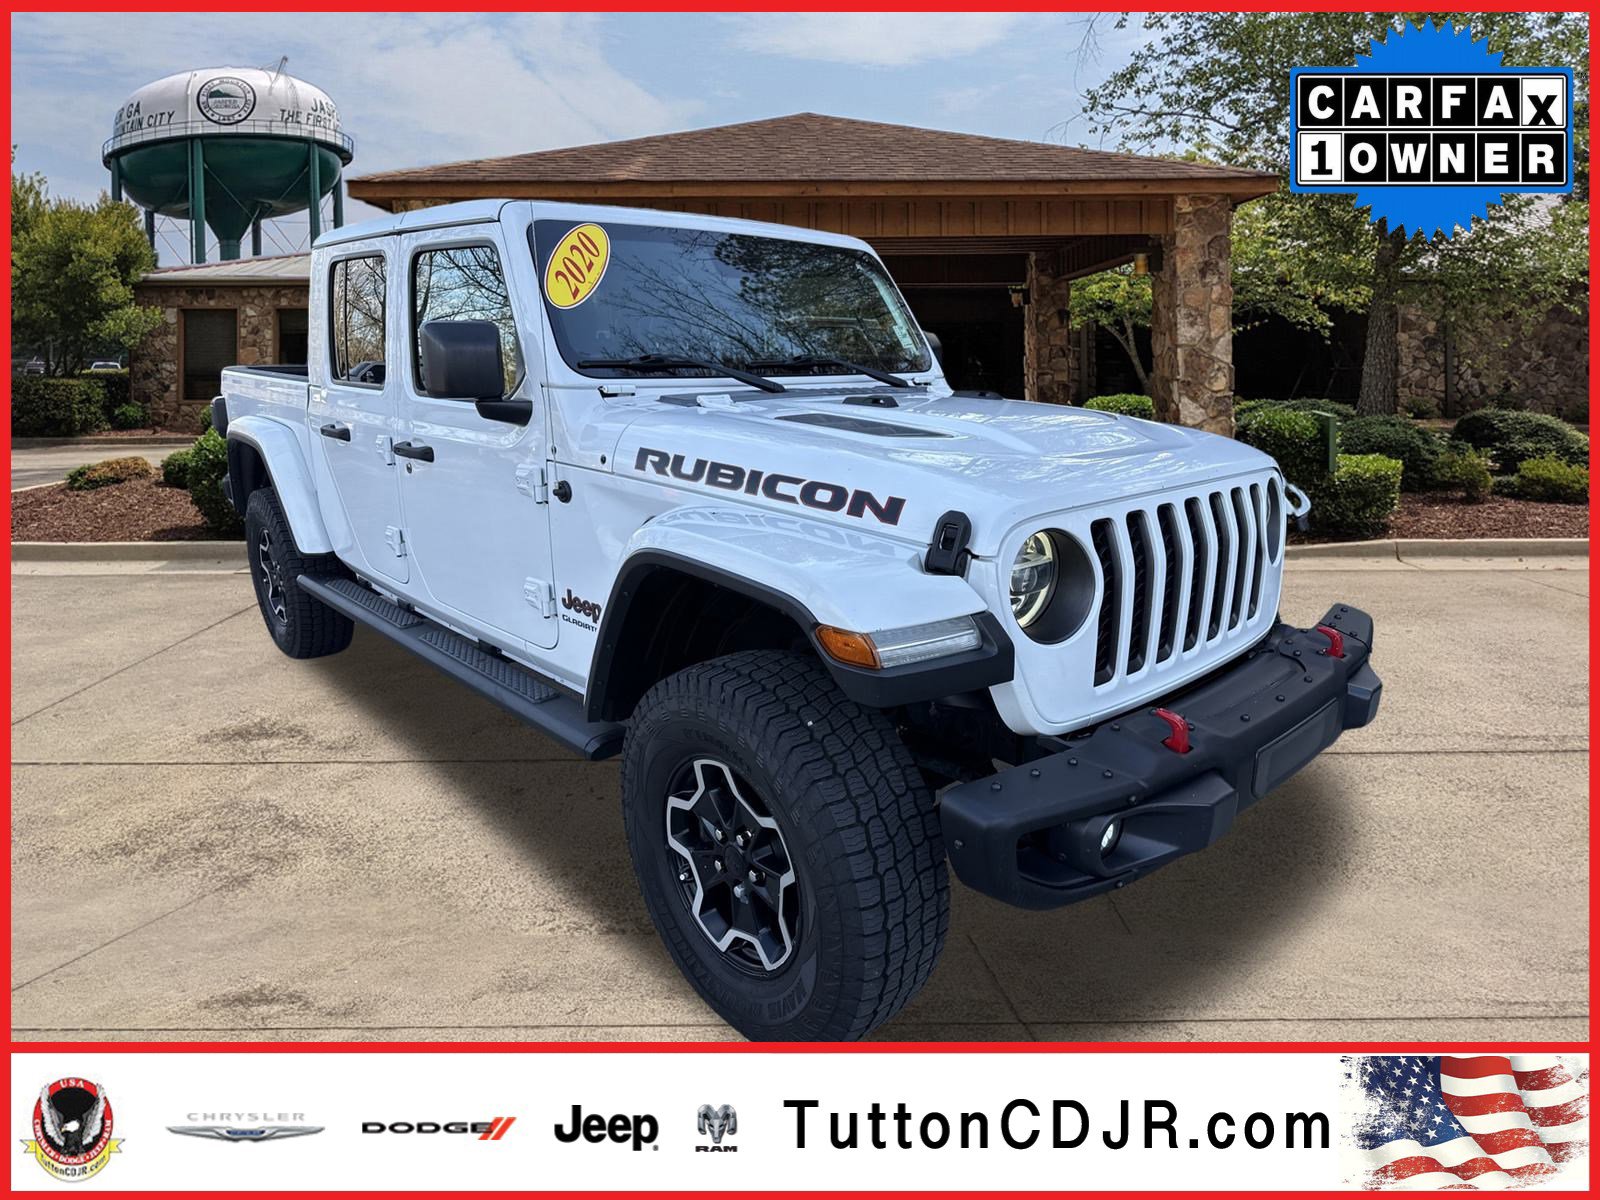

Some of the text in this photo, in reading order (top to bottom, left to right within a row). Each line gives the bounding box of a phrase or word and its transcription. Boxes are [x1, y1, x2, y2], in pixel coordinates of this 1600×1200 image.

[126, 100, 141, 119] GA
[147, 110, 175, 128] CITY
[280, 108, 303, 124] THE
[306, 112, 331, 130] FIRST
[554, 231, 600, 300] 2020
[634, 447, 906, 526] RUBICON
[561, 588, 602, 624] Jeep
[562, 614, 598, 632] GLADIAT
